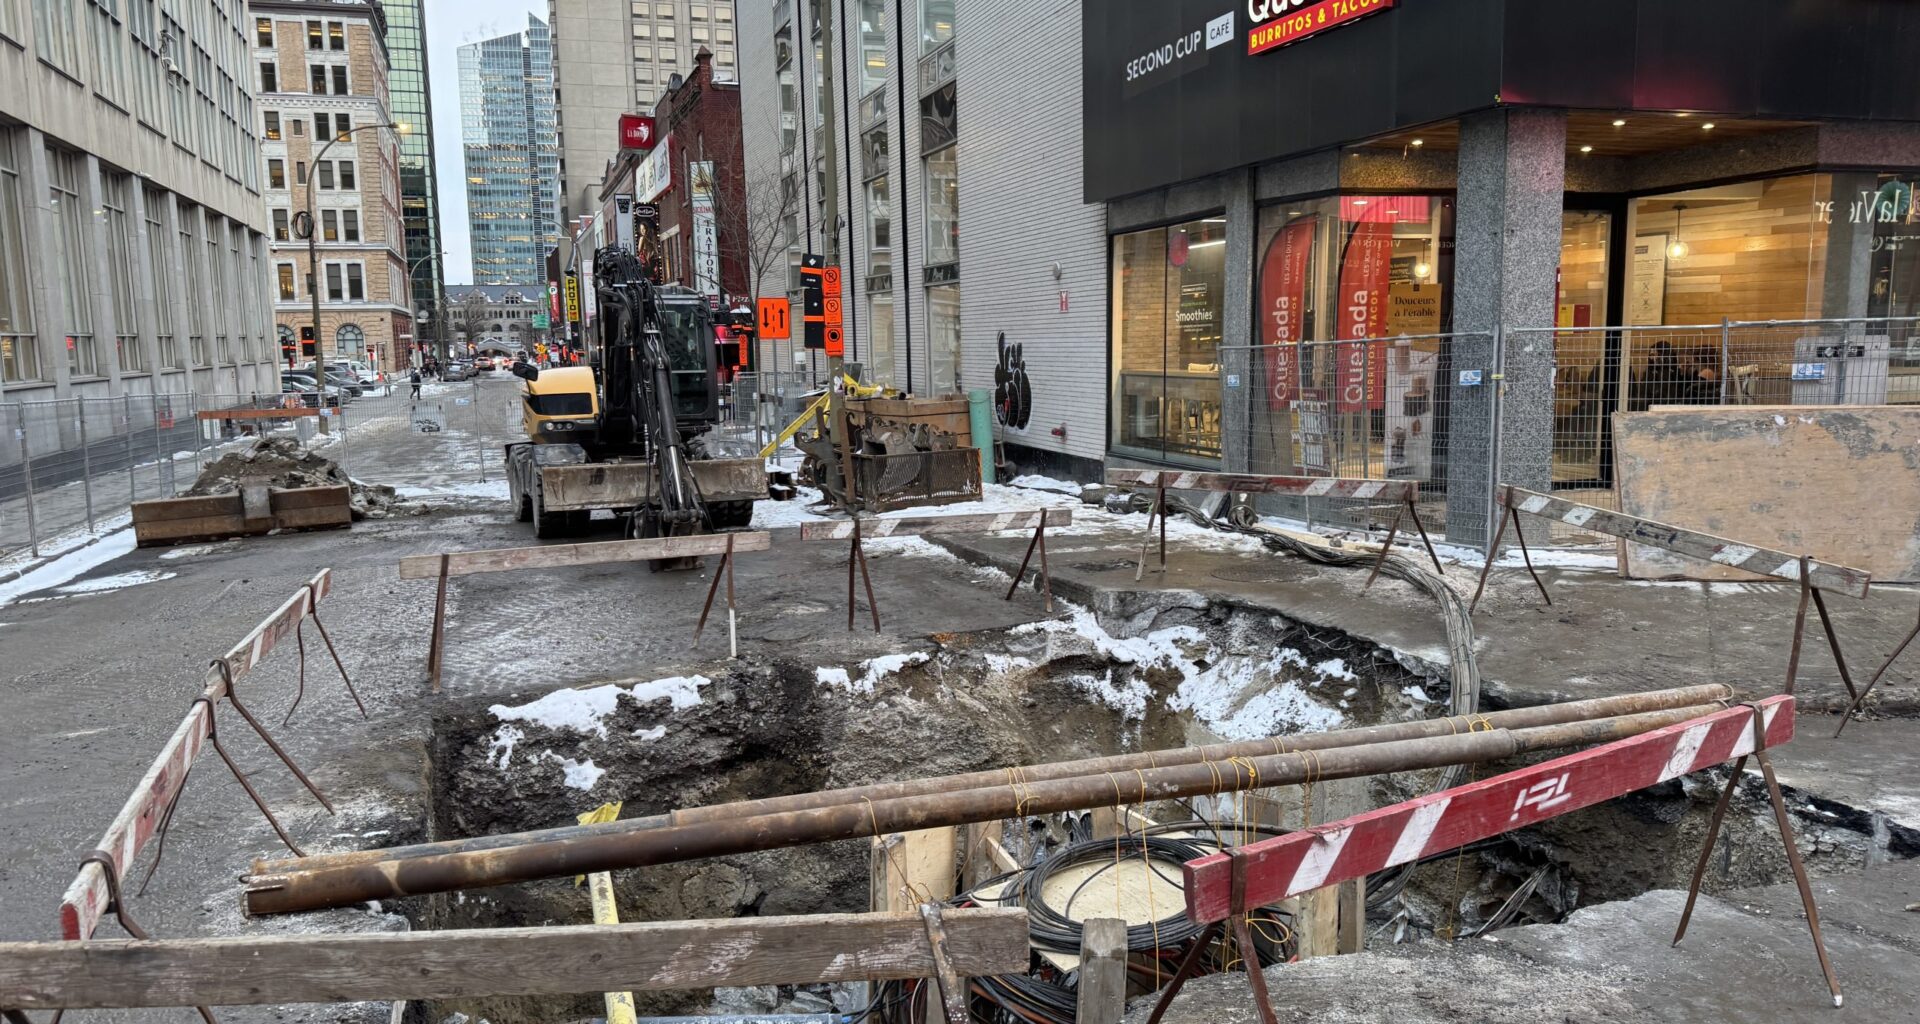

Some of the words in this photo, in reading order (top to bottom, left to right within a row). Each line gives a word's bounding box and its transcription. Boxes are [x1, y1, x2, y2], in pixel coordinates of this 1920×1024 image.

[1126, 43, 1173, 82] SECOND
[1175, 30, 1202, 59] CUP
[1209, 18, 1230, 40] CAFÉ
[1251, 13, 1312, 49] BURRITOS
[1317, 7, 1326, 24] &
[1332, 0, 1380, 18] TACO
[703, 219, 715, 290] TRATTORIA
[567, 279, 576, 310] PHOTO
[1175, 308, 1213, 322] Smoothies
[1369, 290, 1378, 328] TACOS
[1394, 296, 1436, 305] Douceurs
[1272, 296, 1289, 400] Quesada
[1344, 290, 1368, 404] Quesada
[1367, 344, 1376, 400] BURRITOS
